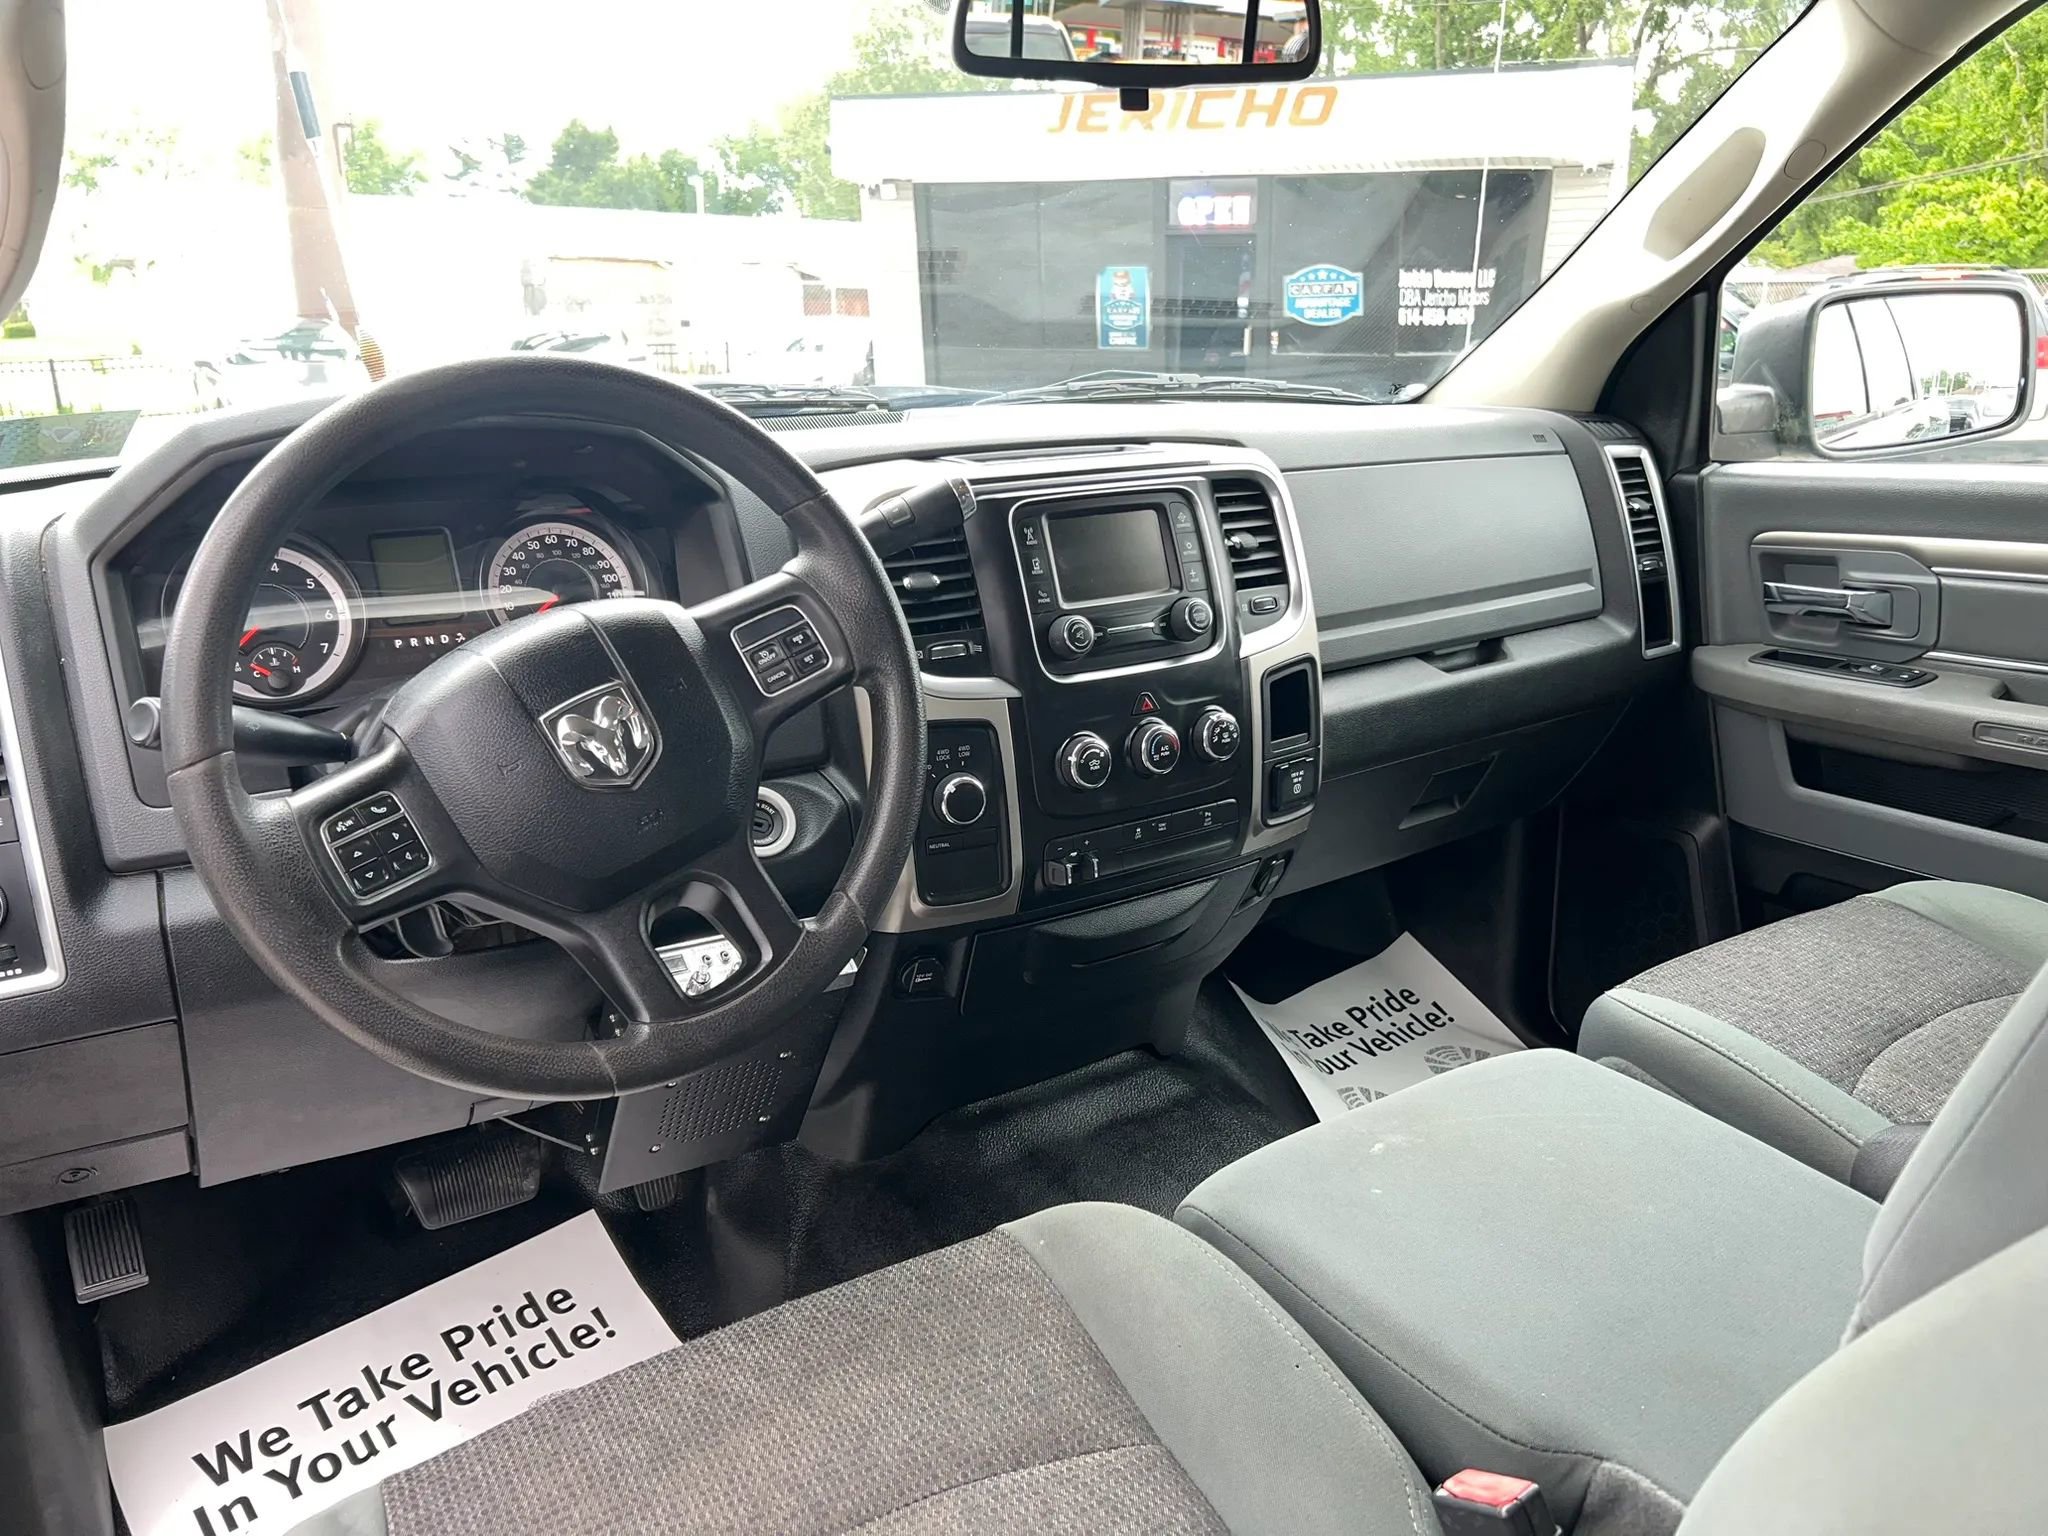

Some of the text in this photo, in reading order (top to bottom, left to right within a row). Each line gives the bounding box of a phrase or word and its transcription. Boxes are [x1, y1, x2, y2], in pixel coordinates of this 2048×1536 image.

[1047, 86, 1338, 133] JERICHO
[1399, 288, 1421, 306] DBA
[1422, 288, 1456, 306] Jericho
[545, 535, 558, 544] 60
[565, 538, 578, 548] 70
[527, 540, 540, 550] 50
[512, 552, 525, 561] 40
[582, 547, 595, 556] 80
[271, 563, 279, 573] 4
[597, 560, 610, 569] 90
[503, 566, 517, 576] 30
[306, 578, 316, 589] 5
[602, 574, 619, 583] 100
[500, 584, 513, 594] 20
[504, 602, 514, 611] 10
[324, 609, 333, 620] 6
[394, 634, 449, 648] P R N D
[319, 643, 329, 654] 7
[293, 666, 301, 674] H
[767, 670, 787, 683] CANCEL
[1287, 1023, 1354, 1049] Take
[1345, 985, 1420, 1029] Pride
[1300, 1049, 1358, 1075] our
[1346, 1001, 1455, 1058] Vehicle!
[191, 1286, 578, 1487] We Take Pride
[193, 1306, 618, 1536] In Your Vehicle!
